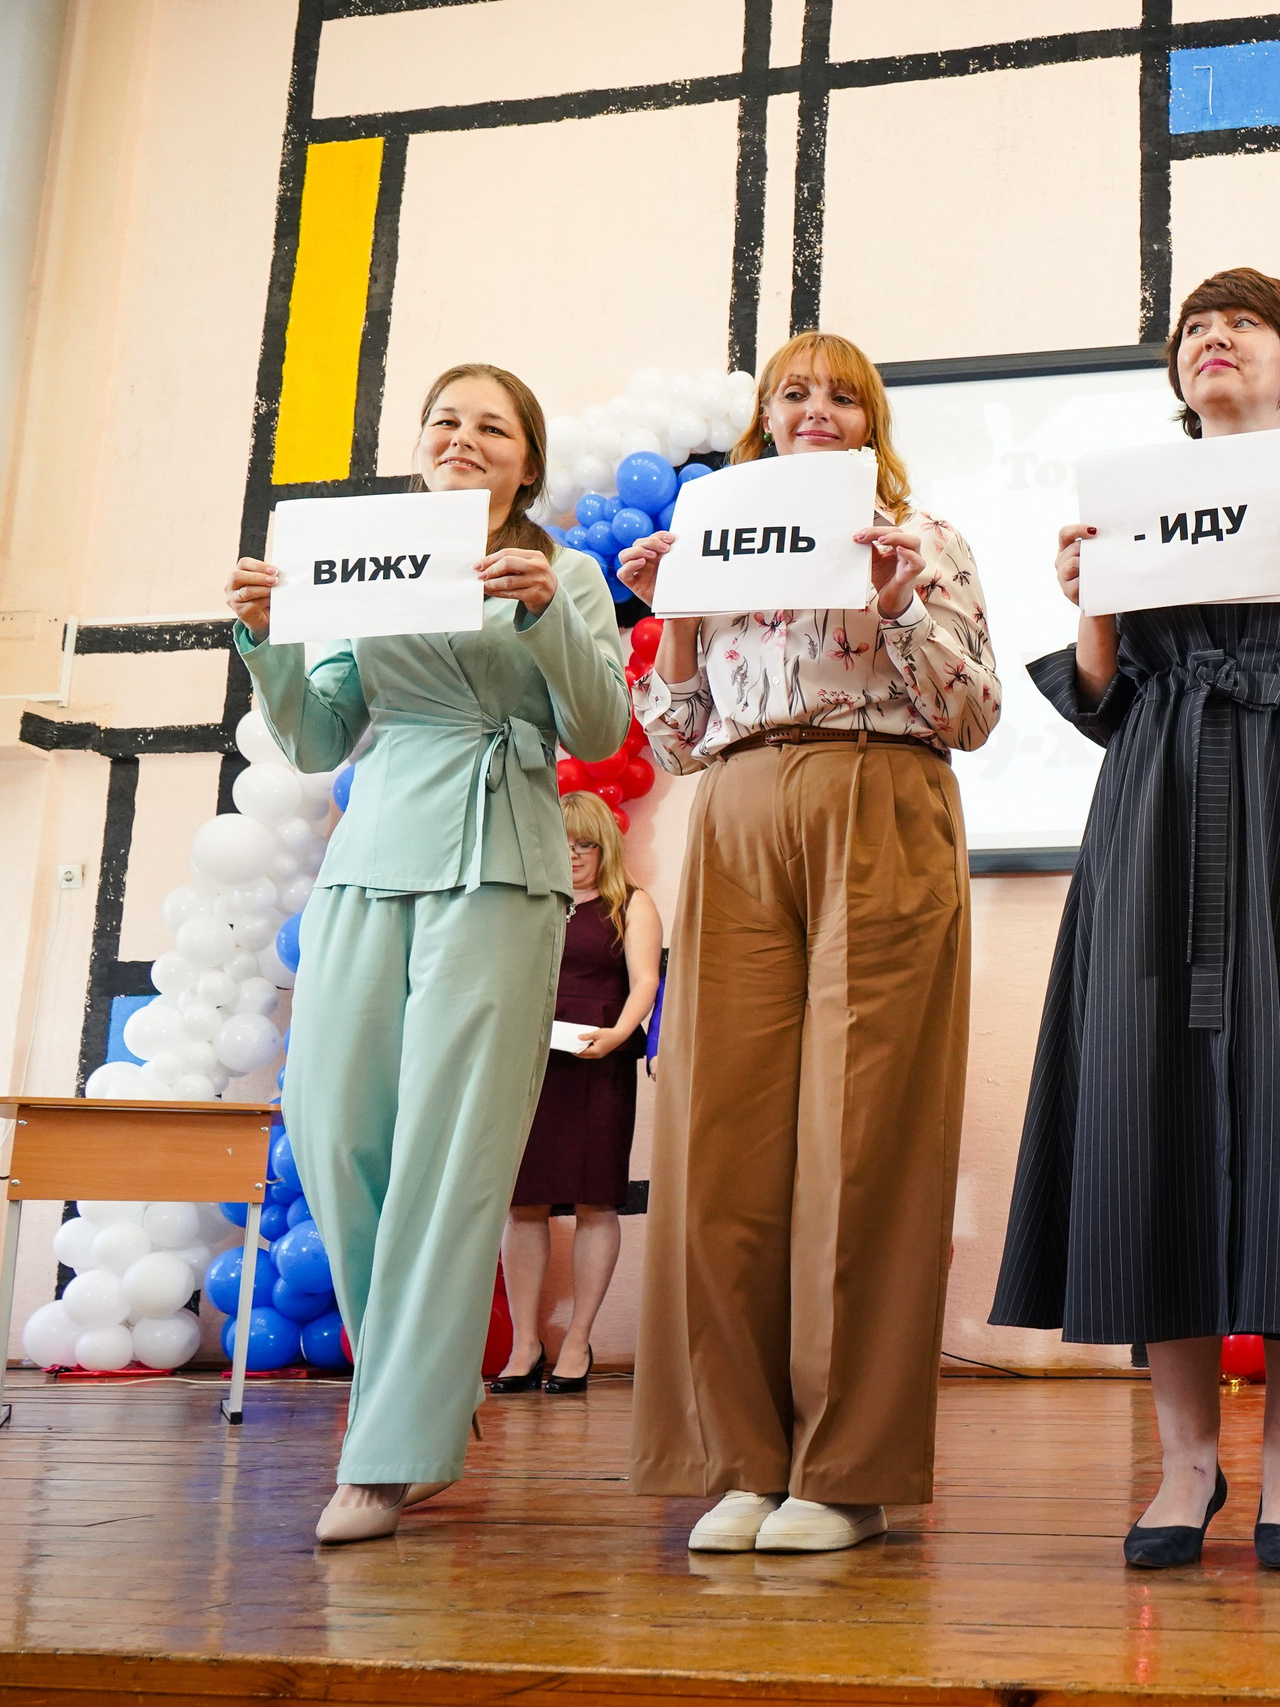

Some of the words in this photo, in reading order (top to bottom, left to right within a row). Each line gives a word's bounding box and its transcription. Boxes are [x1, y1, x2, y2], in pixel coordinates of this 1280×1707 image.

[1159, 504, 1249, 545] ИДУ
[701, 526, 817, 562] ЦЕЛЬ
[313, 554, 432, 585] ВИЖУ
